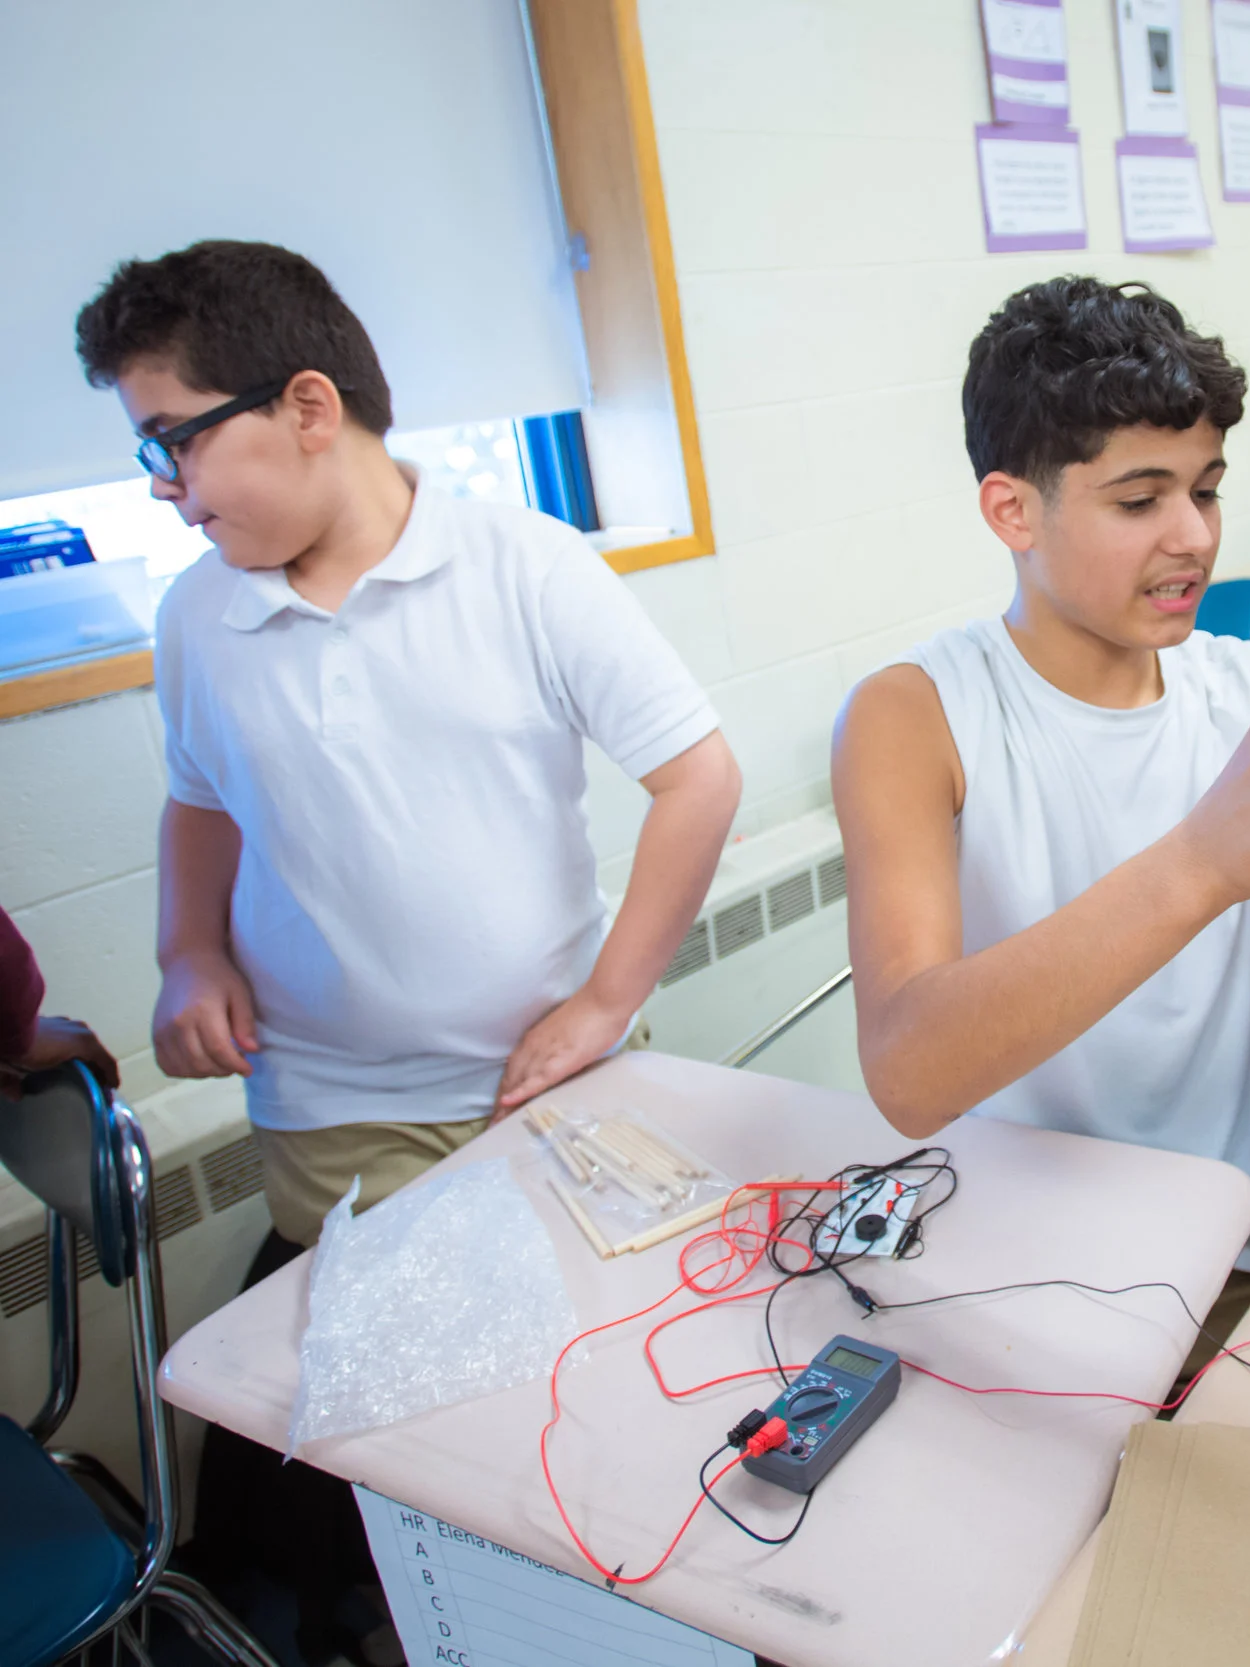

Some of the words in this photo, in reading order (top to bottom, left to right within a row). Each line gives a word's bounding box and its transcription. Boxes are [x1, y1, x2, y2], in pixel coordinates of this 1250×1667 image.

[400, 1511, 427, 1532] HR
[437, 1521, 486, 1549] Elena
[415, 1541, 429, 1558] A
[422, 1568, 435, 1586] B
[431, 1595, 444, 1612] C
[438, 1620, 451, 1637] D
[436, 1645, 471, 1667] ACC
